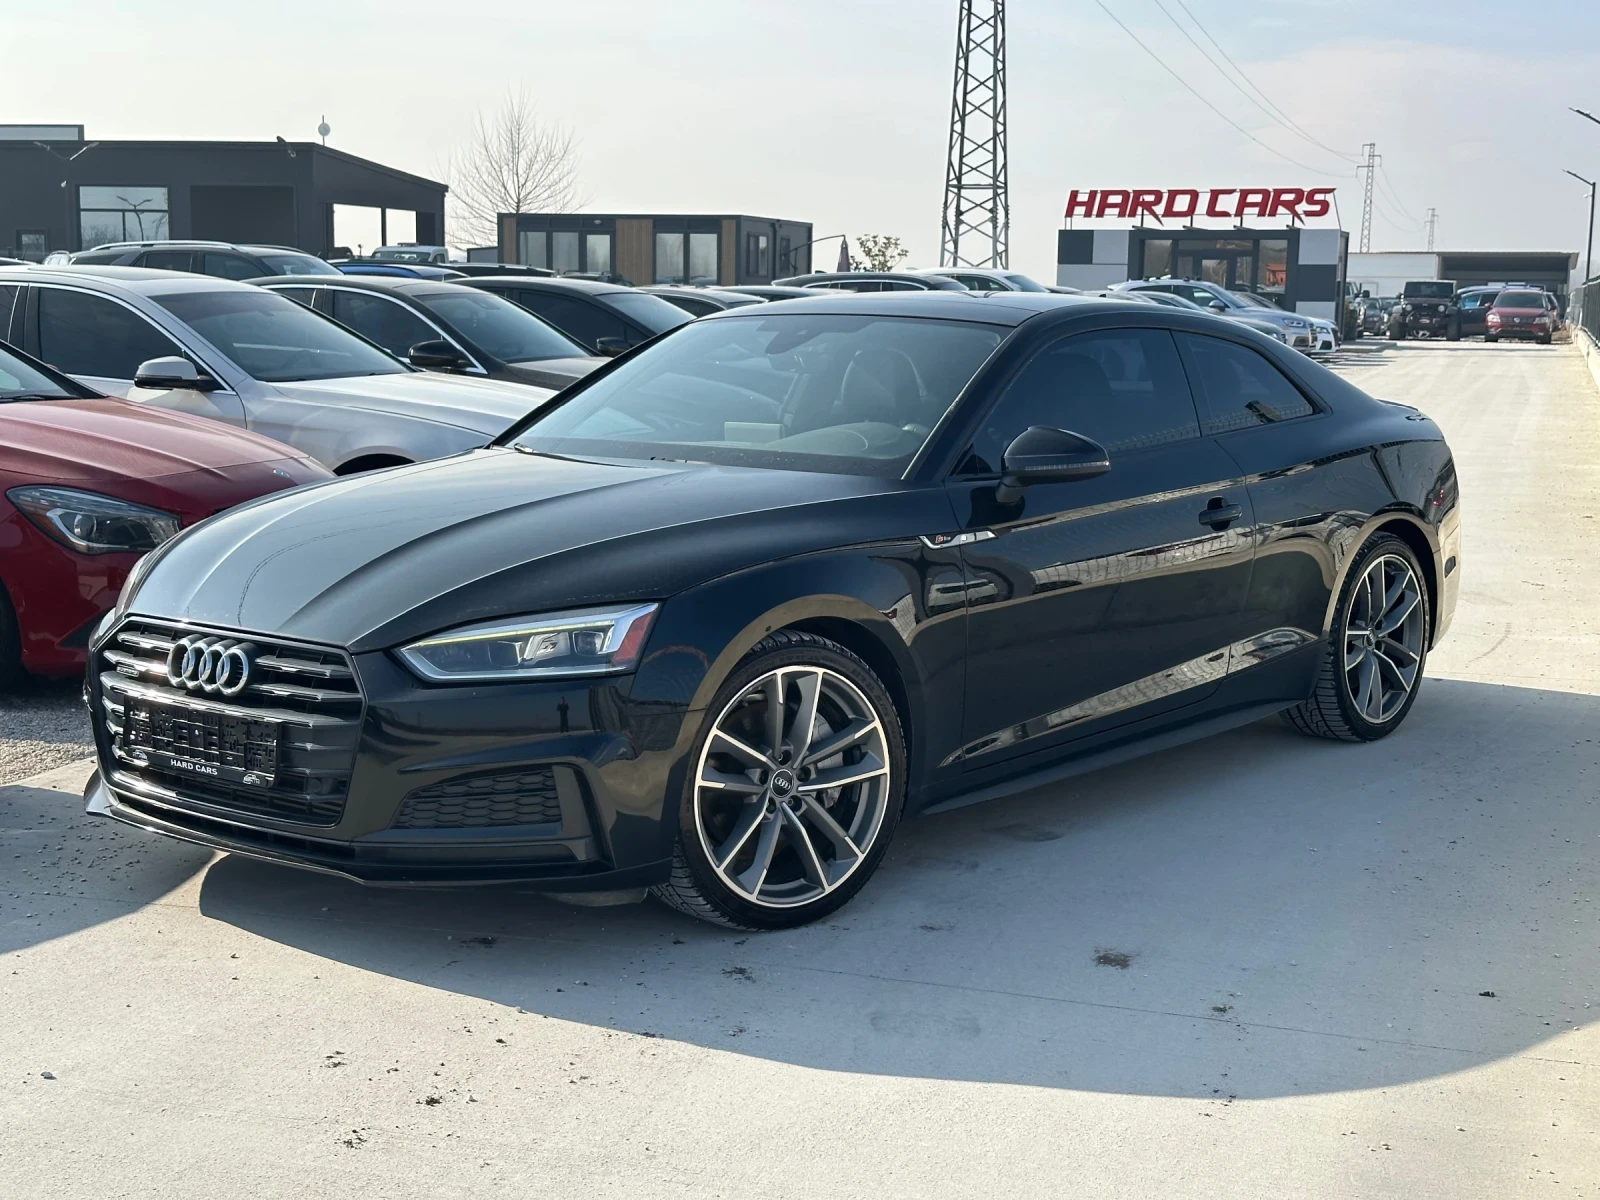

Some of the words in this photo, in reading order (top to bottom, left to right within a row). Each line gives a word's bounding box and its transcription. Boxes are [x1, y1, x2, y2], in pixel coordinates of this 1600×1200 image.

[1064, 189, 1200, 227] HARD
[1205, 188, 1337, 226] CARS
[170, 758, 194, 770] HARD
[195, 764, 218, 776] CARS
